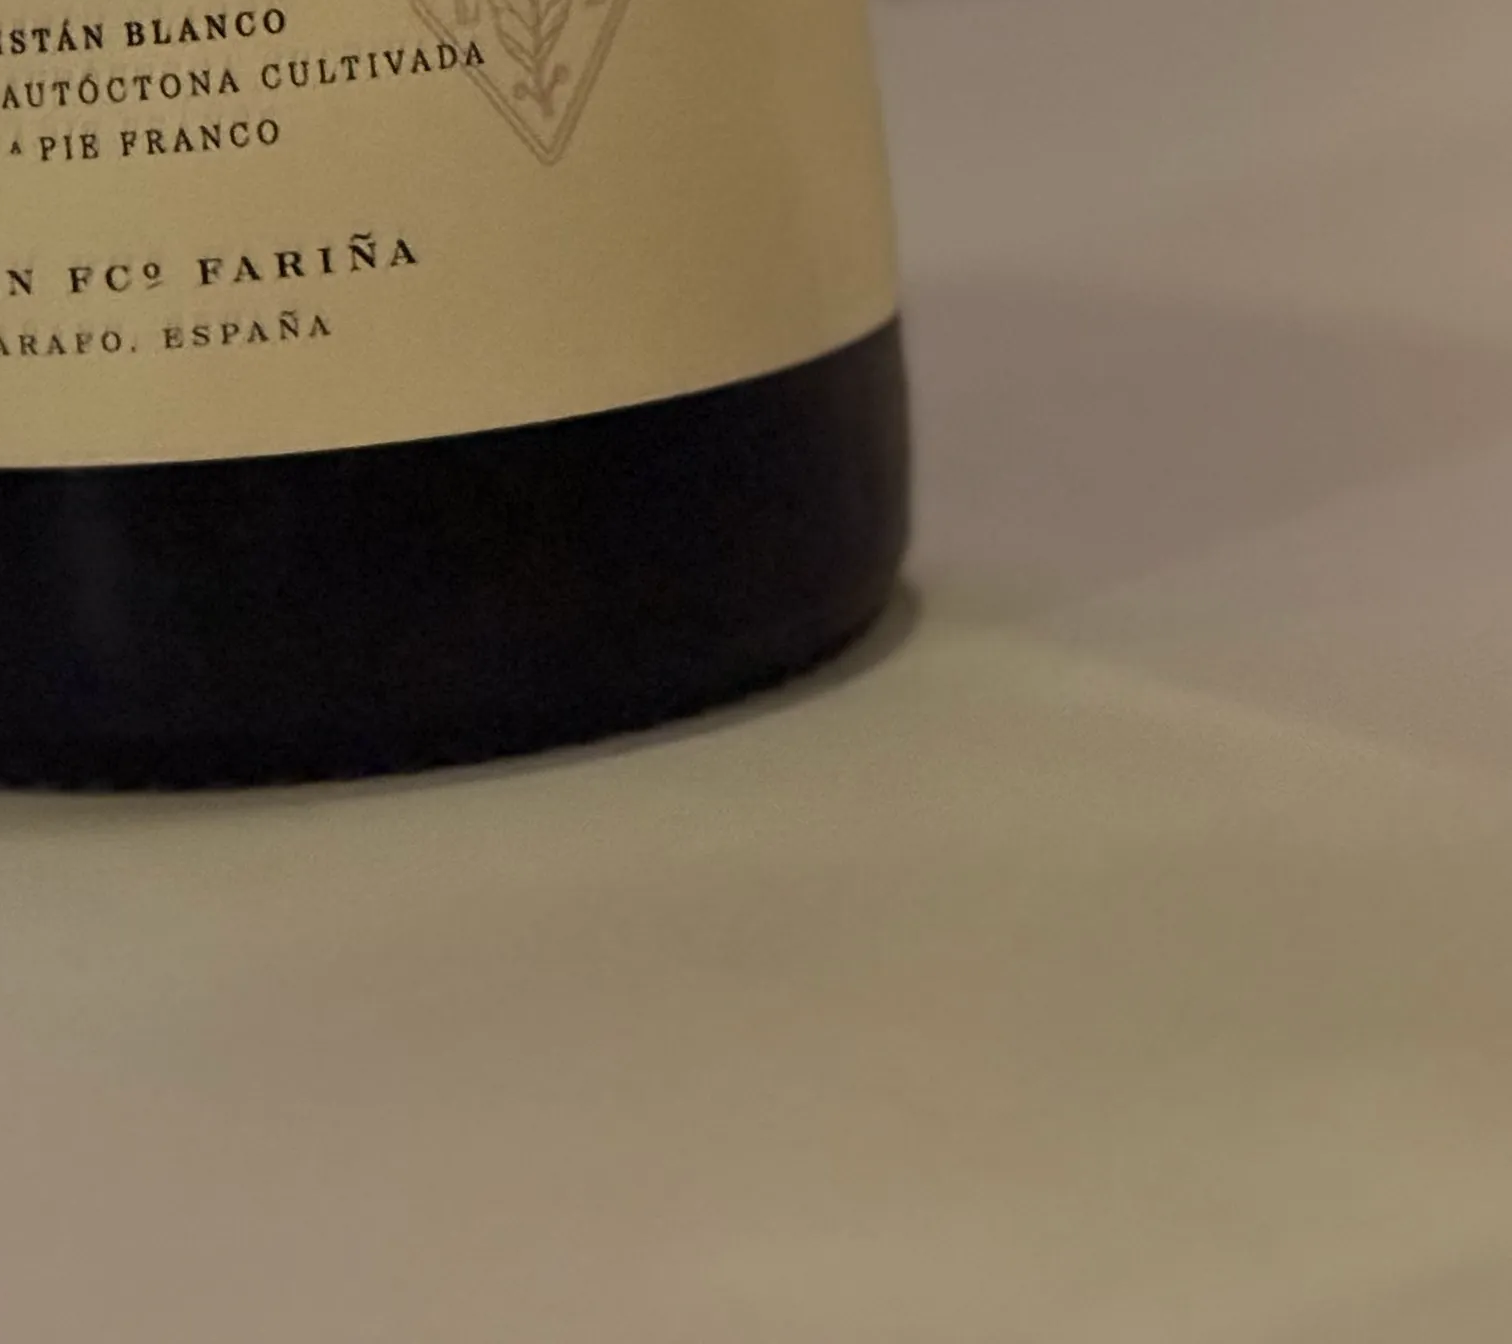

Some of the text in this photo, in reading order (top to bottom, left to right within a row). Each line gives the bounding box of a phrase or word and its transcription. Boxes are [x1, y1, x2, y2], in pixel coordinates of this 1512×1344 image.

[125, 7, 288, 48] BLANCO
[1, 63, 241, 111] AUTÓCTONA
[260, 40, 486, 89] CULTIVADA
[39, 135, 100, 162] PIE
[119, 118, 281, 159] FRANCO
[197, 232, 419, 287] FARIÑA
[163, 310, 333, 351] ESPAÑA
